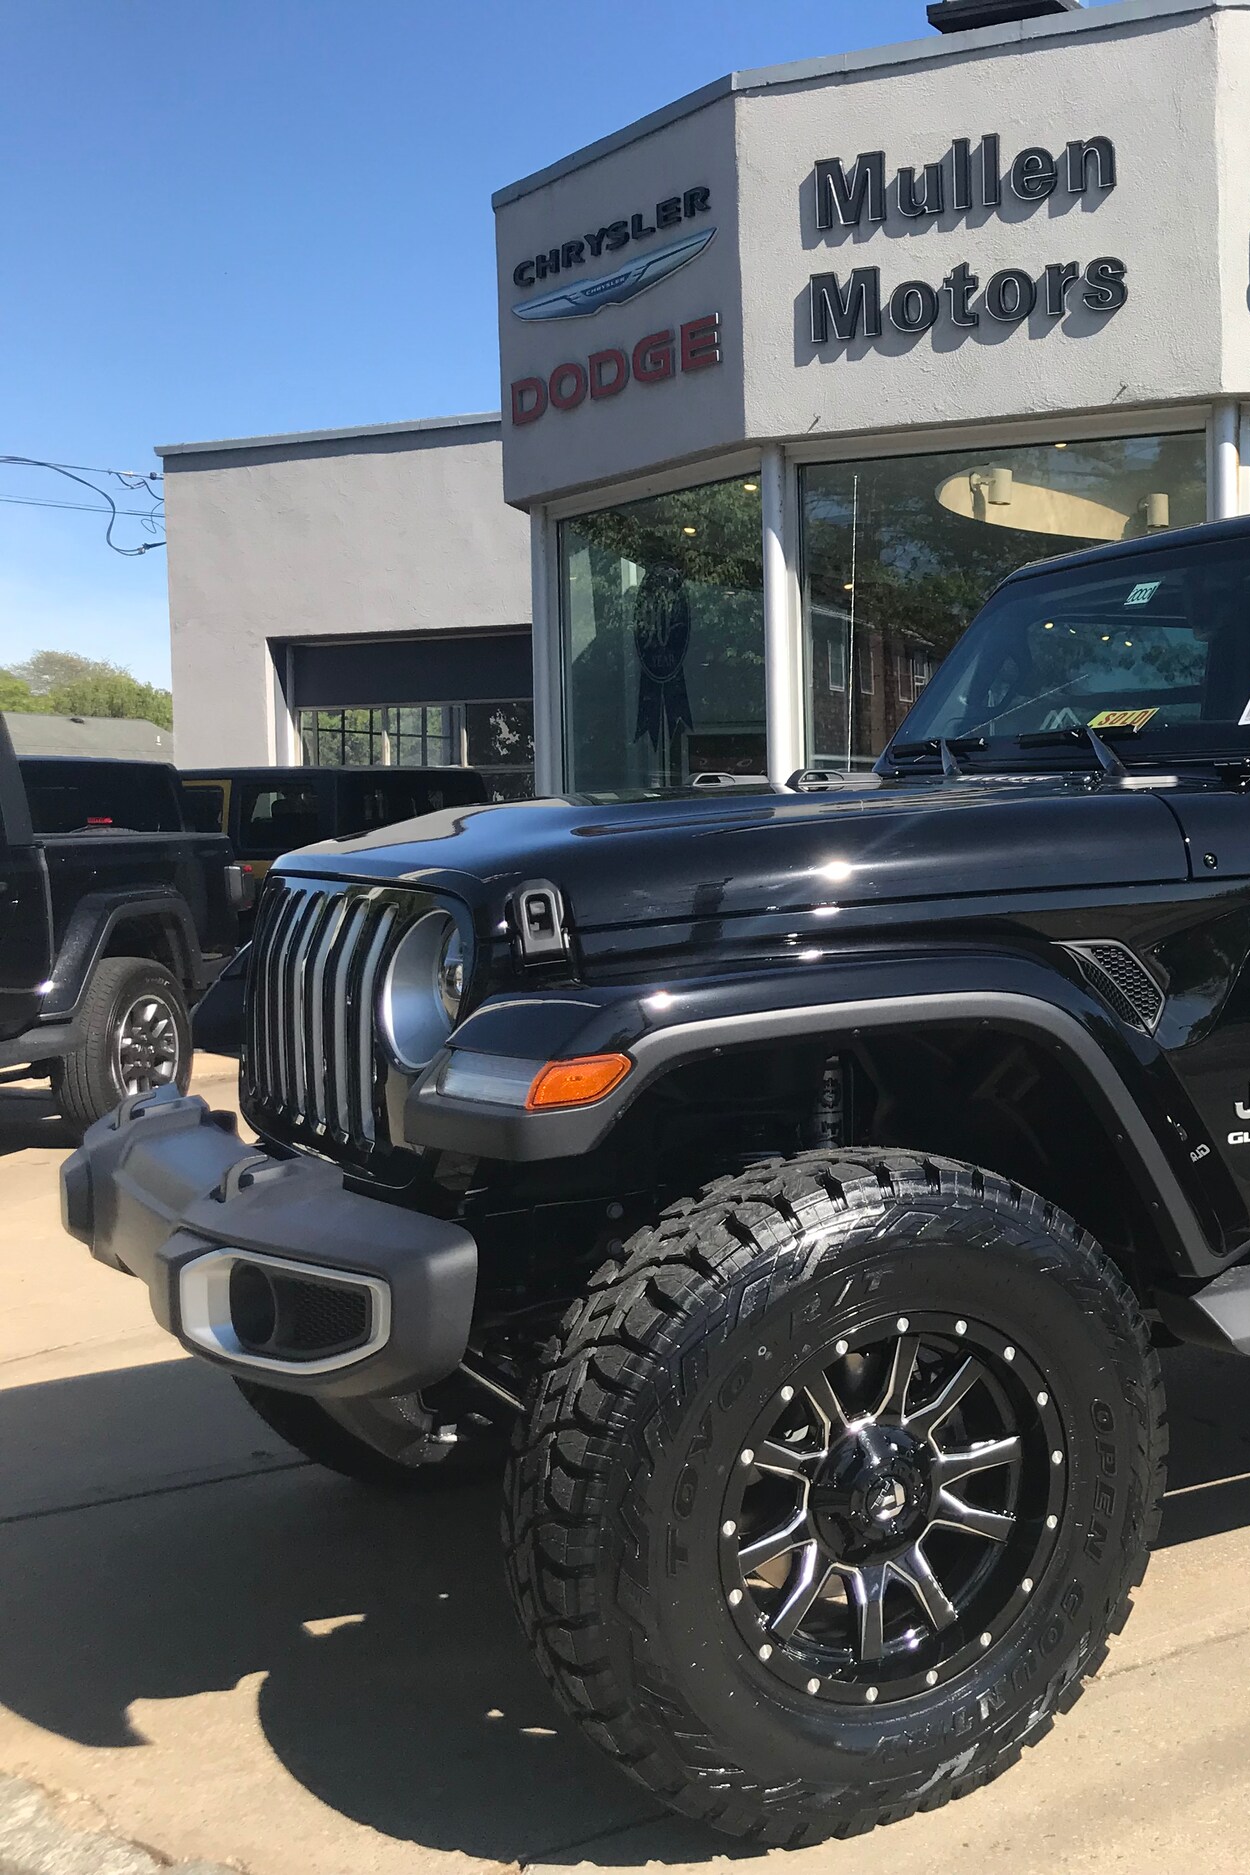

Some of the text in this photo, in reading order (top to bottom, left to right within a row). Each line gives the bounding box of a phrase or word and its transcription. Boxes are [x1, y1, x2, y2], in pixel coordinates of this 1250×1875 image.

[813, 133, 1116, 231] Mullen
[512, 185, 711, 288] CHRYSLER
[808, 255, 1129, 344] Motors
[510, 311, 722, 426] DODGE
[870, 1479, 891, 1510] FUEL
[1082, 1397, 1119, 1566] OPEN
